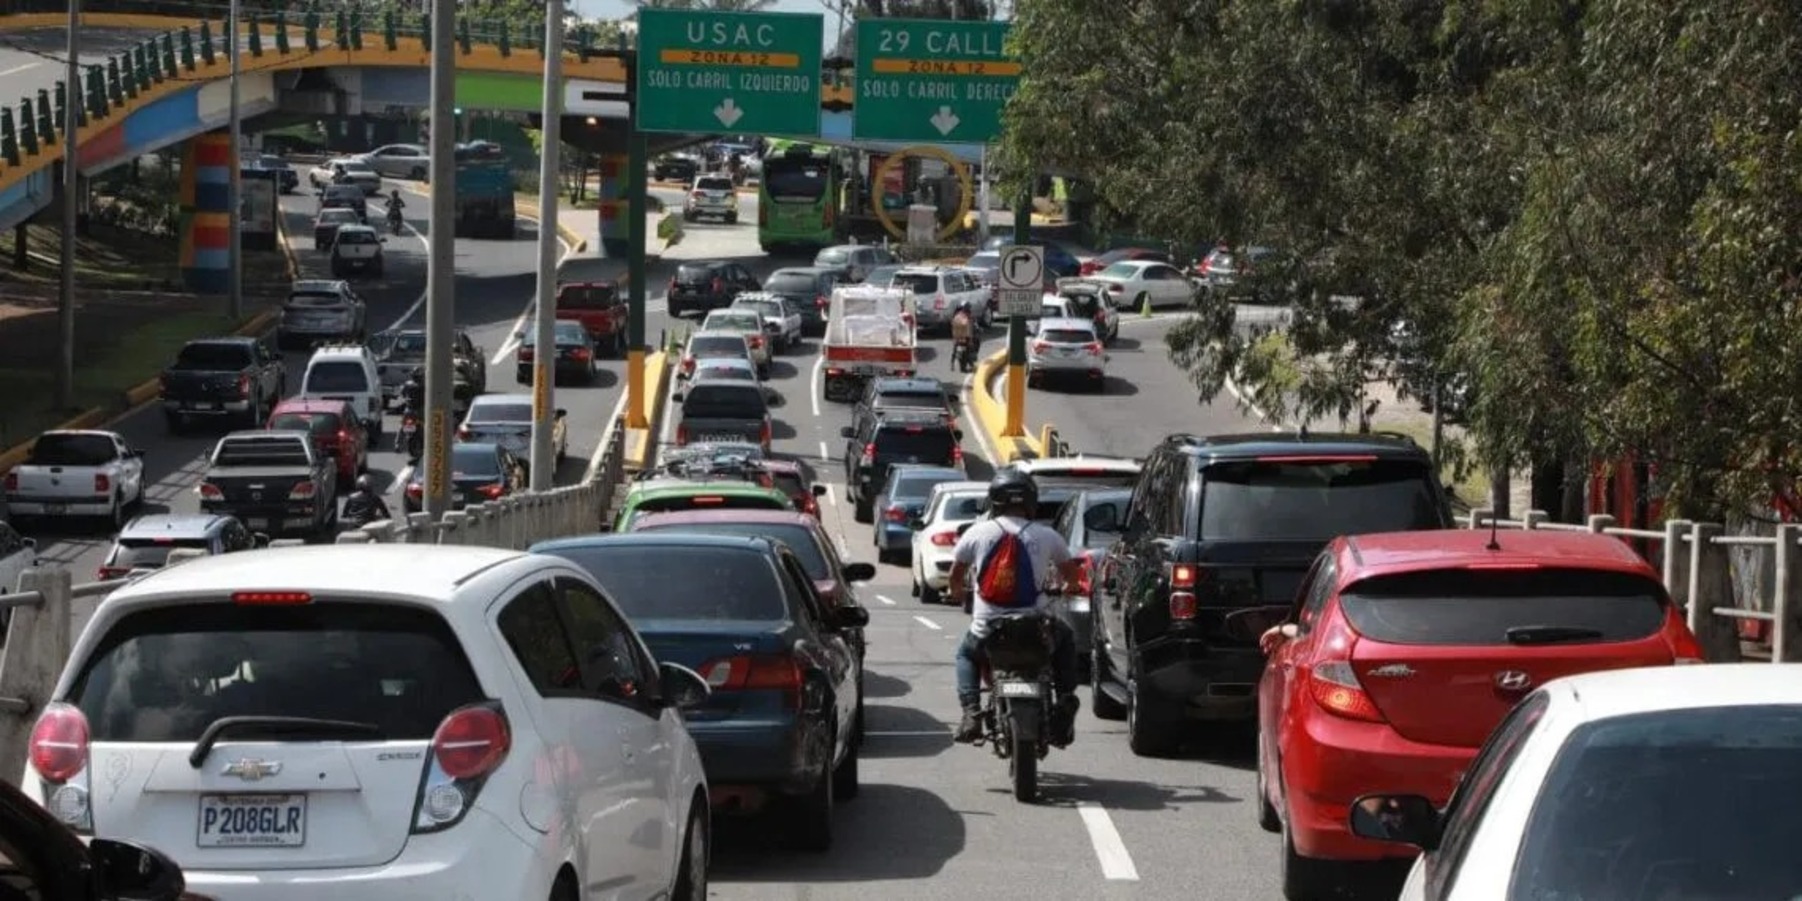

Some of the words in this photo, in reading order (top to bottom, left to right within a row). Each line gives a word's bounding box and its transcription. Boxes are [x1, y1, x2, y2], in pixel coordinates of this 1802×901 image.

[687, 21, 774, 46] USAC
[878, 29, 910, 51] 29
[689, 51, 743, 64] ZONA
[751, 53, 770, 65] 12
[908, 60, 957, 74] ZONA
[967, 63, 985, 75] 12
[647, 70, 681, 88] SOLO
[687, 71, 732, 90] CARRIL
[740, 73, 811, 93] IZQUIERDO
[862, 79, 899, 98] SOLO
[908, 81, 958, 99] CARRIL
[966, 83, 1014, 101] DEREC
[203, 807, 300, 834] P208GLR
